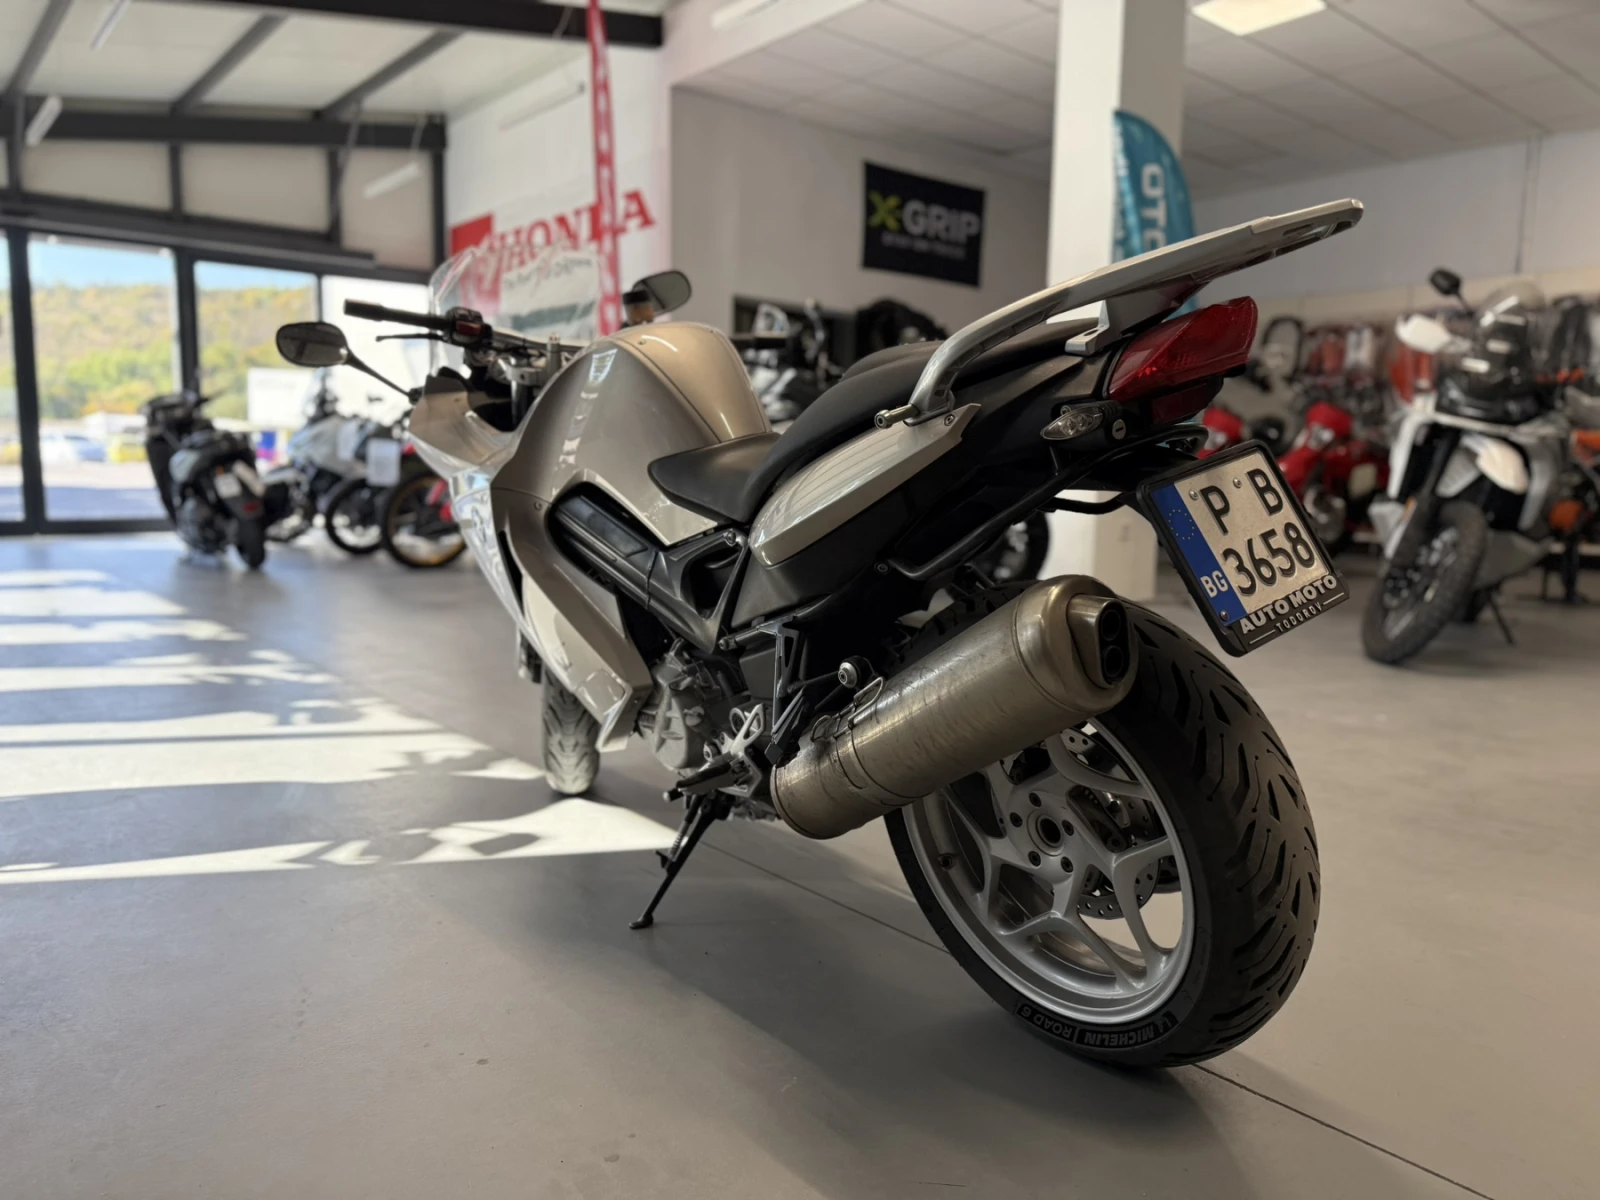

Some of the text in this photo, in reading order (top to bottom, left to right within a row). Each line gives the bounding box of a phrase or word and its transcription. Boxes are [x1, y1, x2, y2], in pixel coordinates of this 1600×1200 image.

[1200, 468, 1283, 535] P B
[1222, 522, 1315, 597] 3658
[1200, 570, 1229, 598] BG
[1239, 574, 1337, 635] AUTO MOTO
[1276, 601, 1323, 632] TODOROV
[1033, 1013, 1073, 1038] ROAD
[1084, 1026, 1155, 1046] MICHELIN
